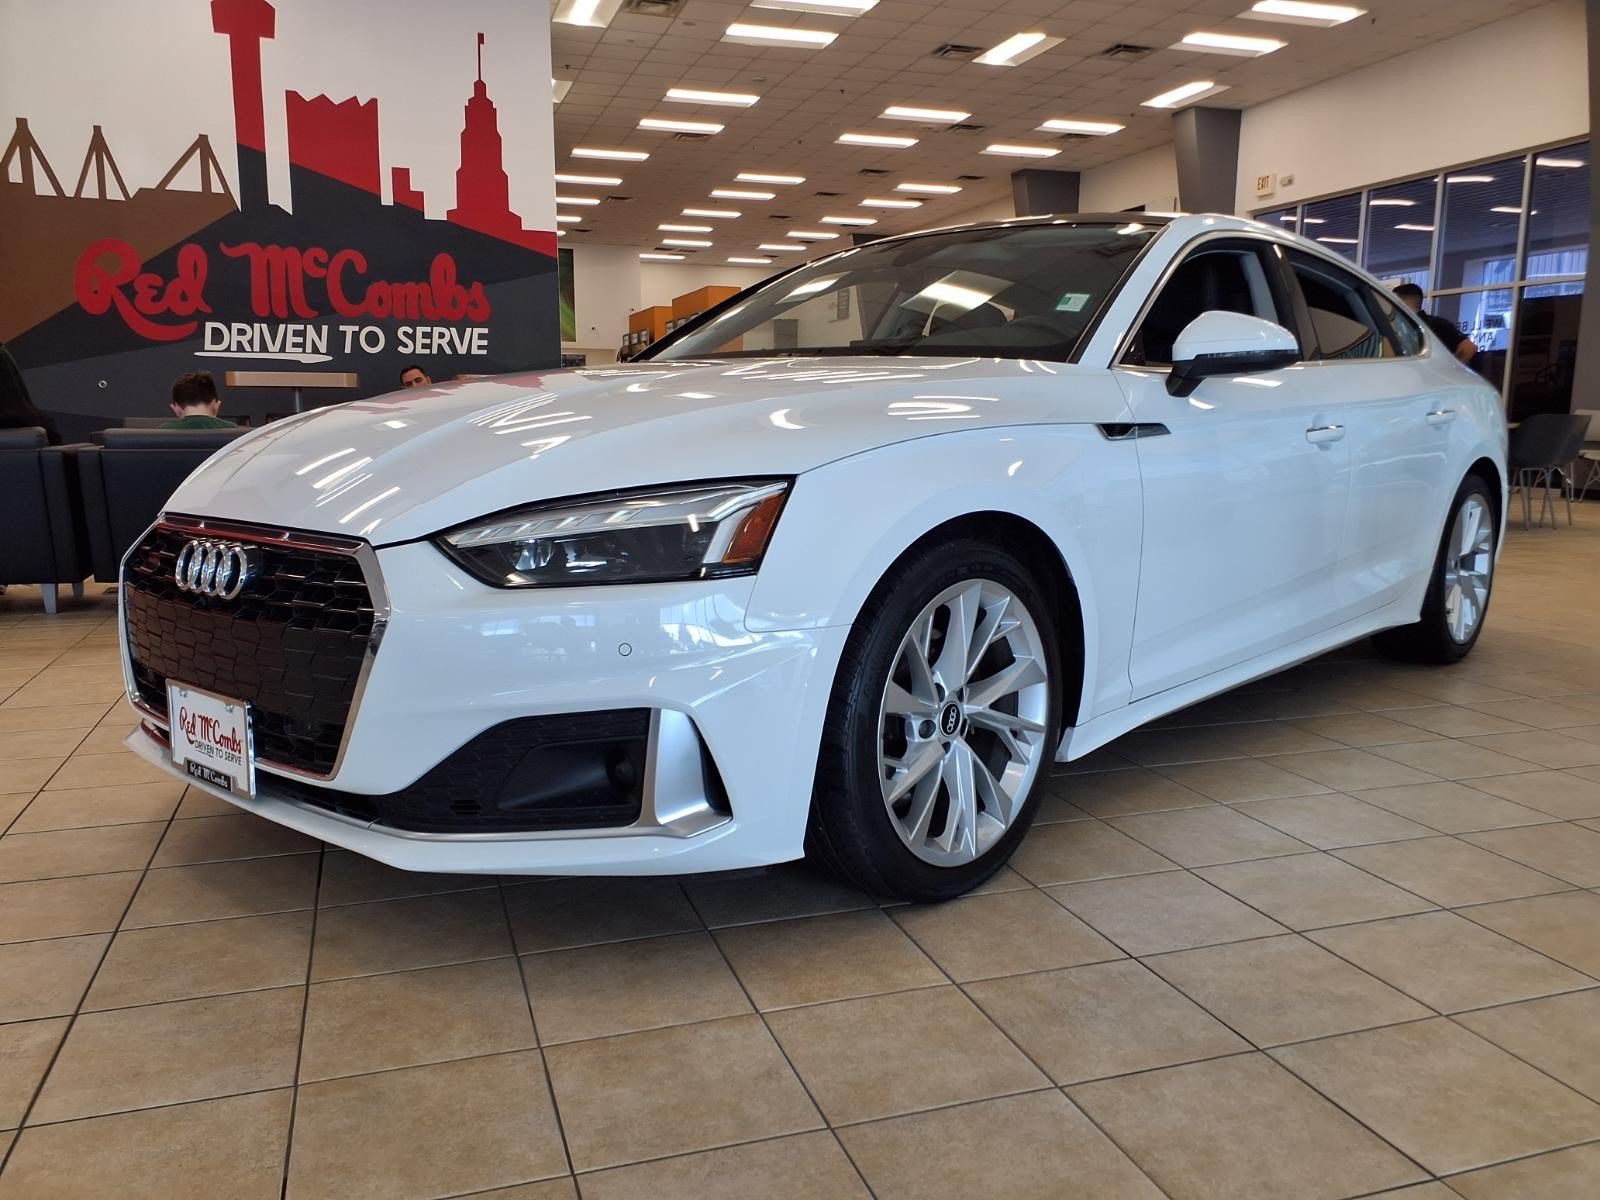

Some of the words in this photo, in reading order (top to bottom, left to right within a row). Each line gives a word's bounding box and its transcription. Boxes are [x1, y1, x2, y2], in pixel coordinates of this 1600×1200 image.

[1257, 176, 1270, 190] EXIT
[73, 238, 213, 341] Red
[219, 241, 490, 322] McCombs
[204, 321, 328, 354] DRIVEN
[339, 325, 386, 353] TO
[397, 326, 489, 355] SERVE
[179, 706, 197, 745] Red
[197, 714, 242, 754] McCombs
[194, 740, 214, 755] DRIVEN
[215, 747, 224, 759] TO
[224, 751, 242, 766] SERVE
[190, 762, 201, 777] Red
